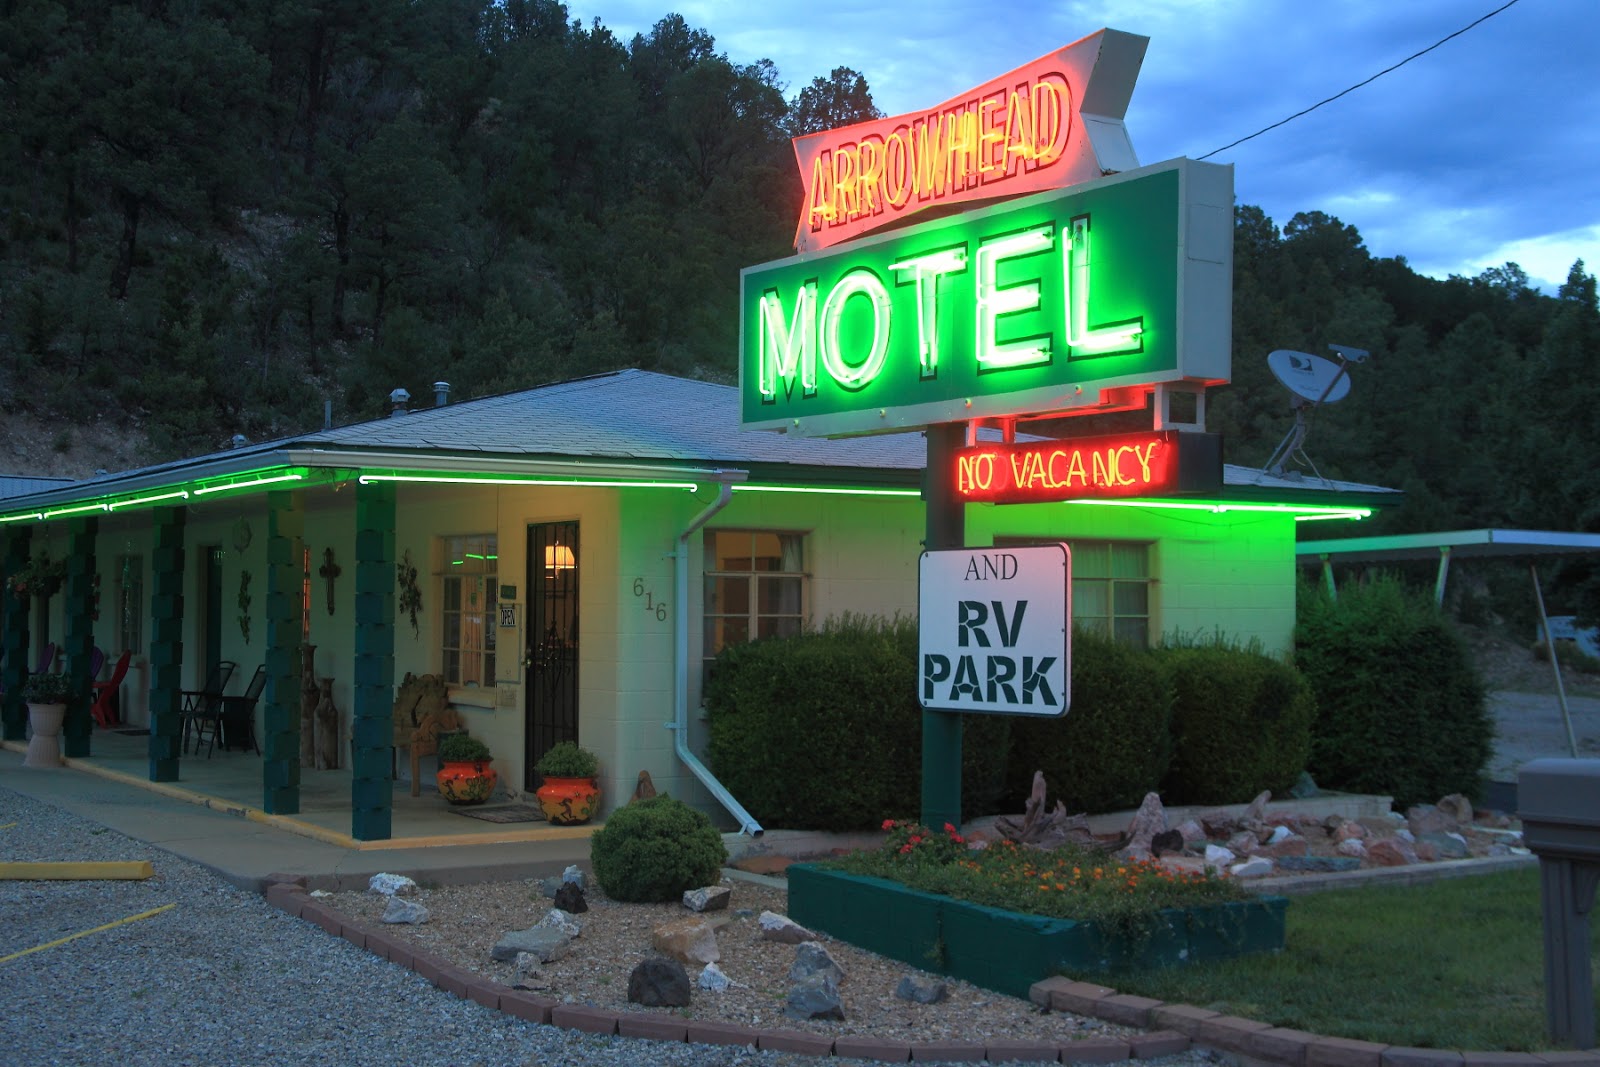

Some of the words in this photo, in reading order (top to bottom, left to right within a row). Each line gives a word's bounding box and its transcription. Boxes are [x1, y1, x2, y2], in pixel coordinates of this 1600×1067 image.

[807, 71, 1072, 233] ARROWHEAD
[758, 213, 1143, 406] MOTEL
[957, 453, 998, 493] NO
[1010, 442, 1162, 489] VACANCY
[963, 553, 1018, 582] AND
[500, 609, 515, 625] OPEN
[633, 577, 666, 622] 616
[957, 600, 1028, 648] RV
[923, 653, 1058, 707] PARK
